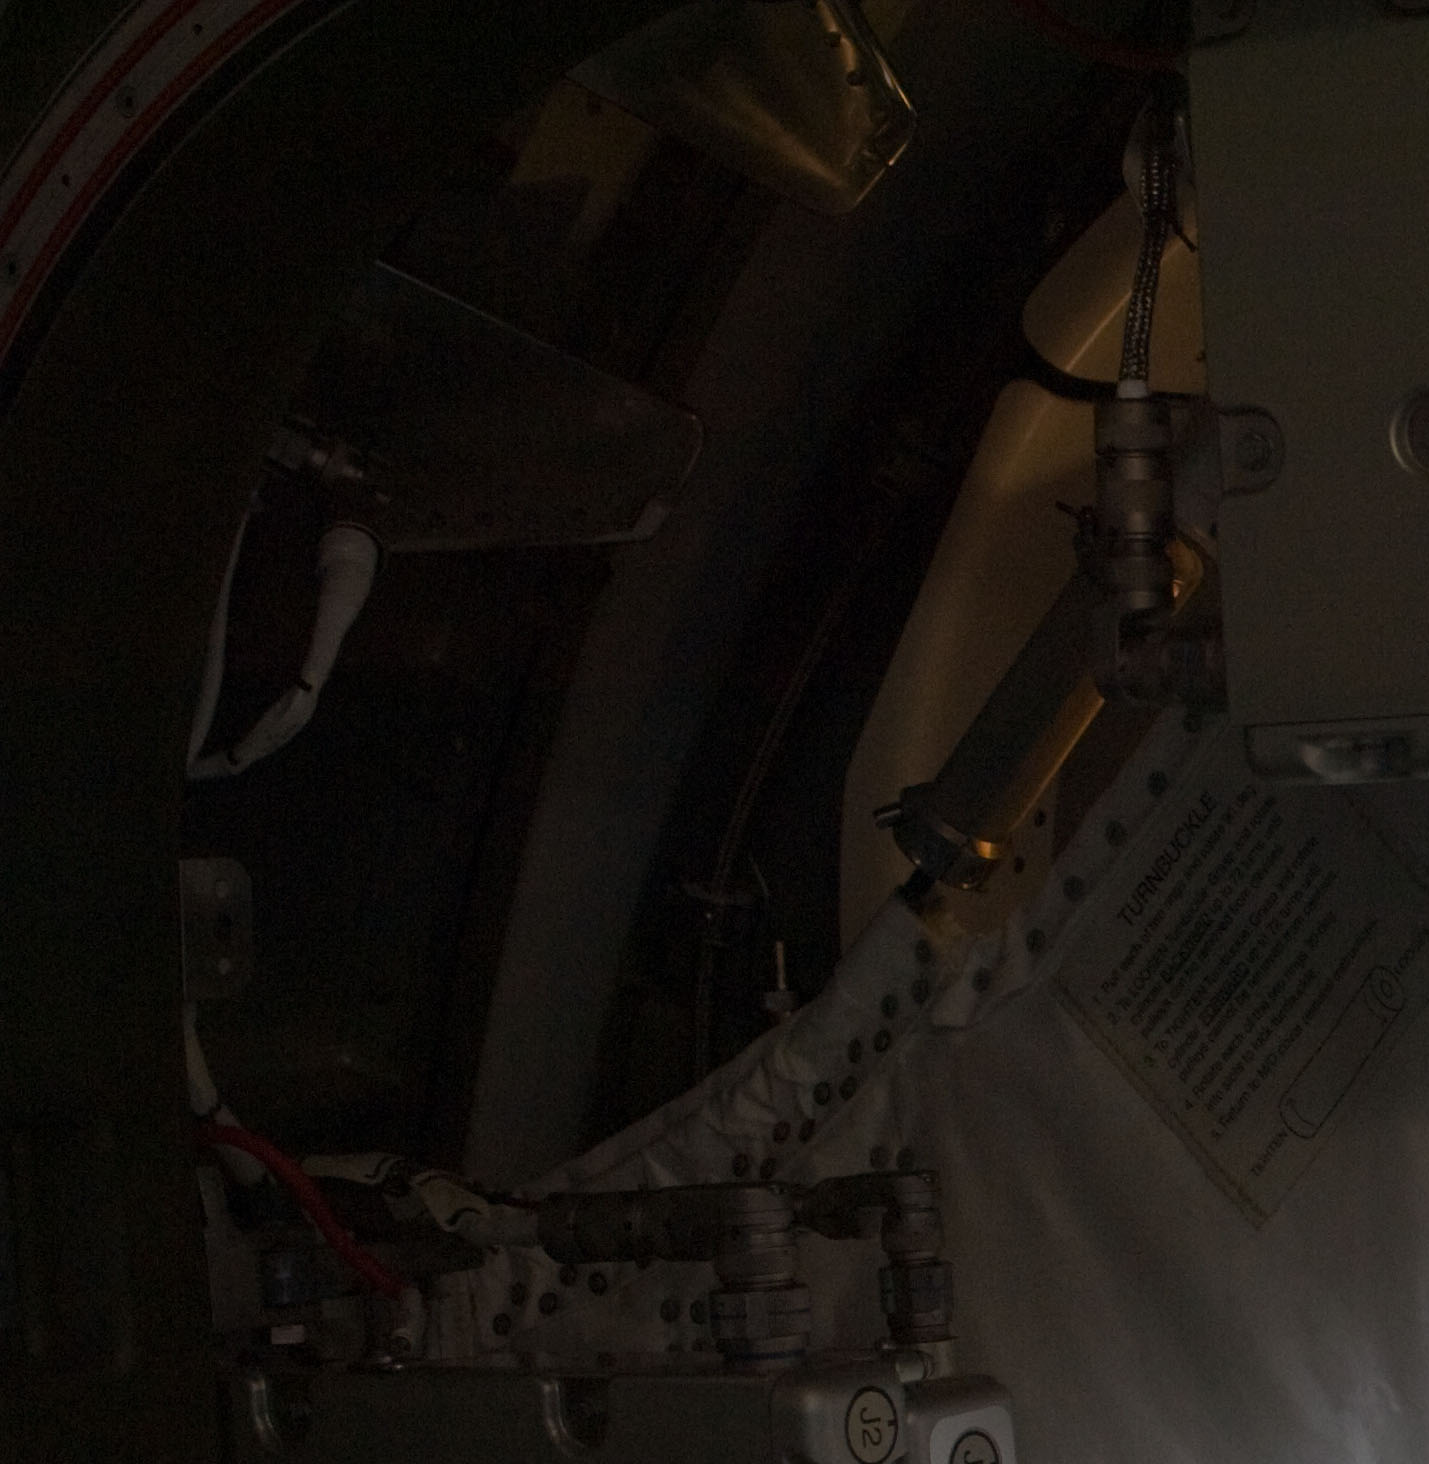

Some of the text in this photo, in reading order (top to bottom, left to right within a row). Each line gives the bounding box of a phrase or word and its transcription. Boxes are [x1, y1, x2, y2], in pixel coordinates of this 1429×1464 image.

[1114, 789, 1219, 930] TURNBUCKLE
[1126, 941, 1170, 999] LOOSEN
[1164, 982, 1209, 1041] TIGHTEN
[859, 1406, 882, 1449] J2
